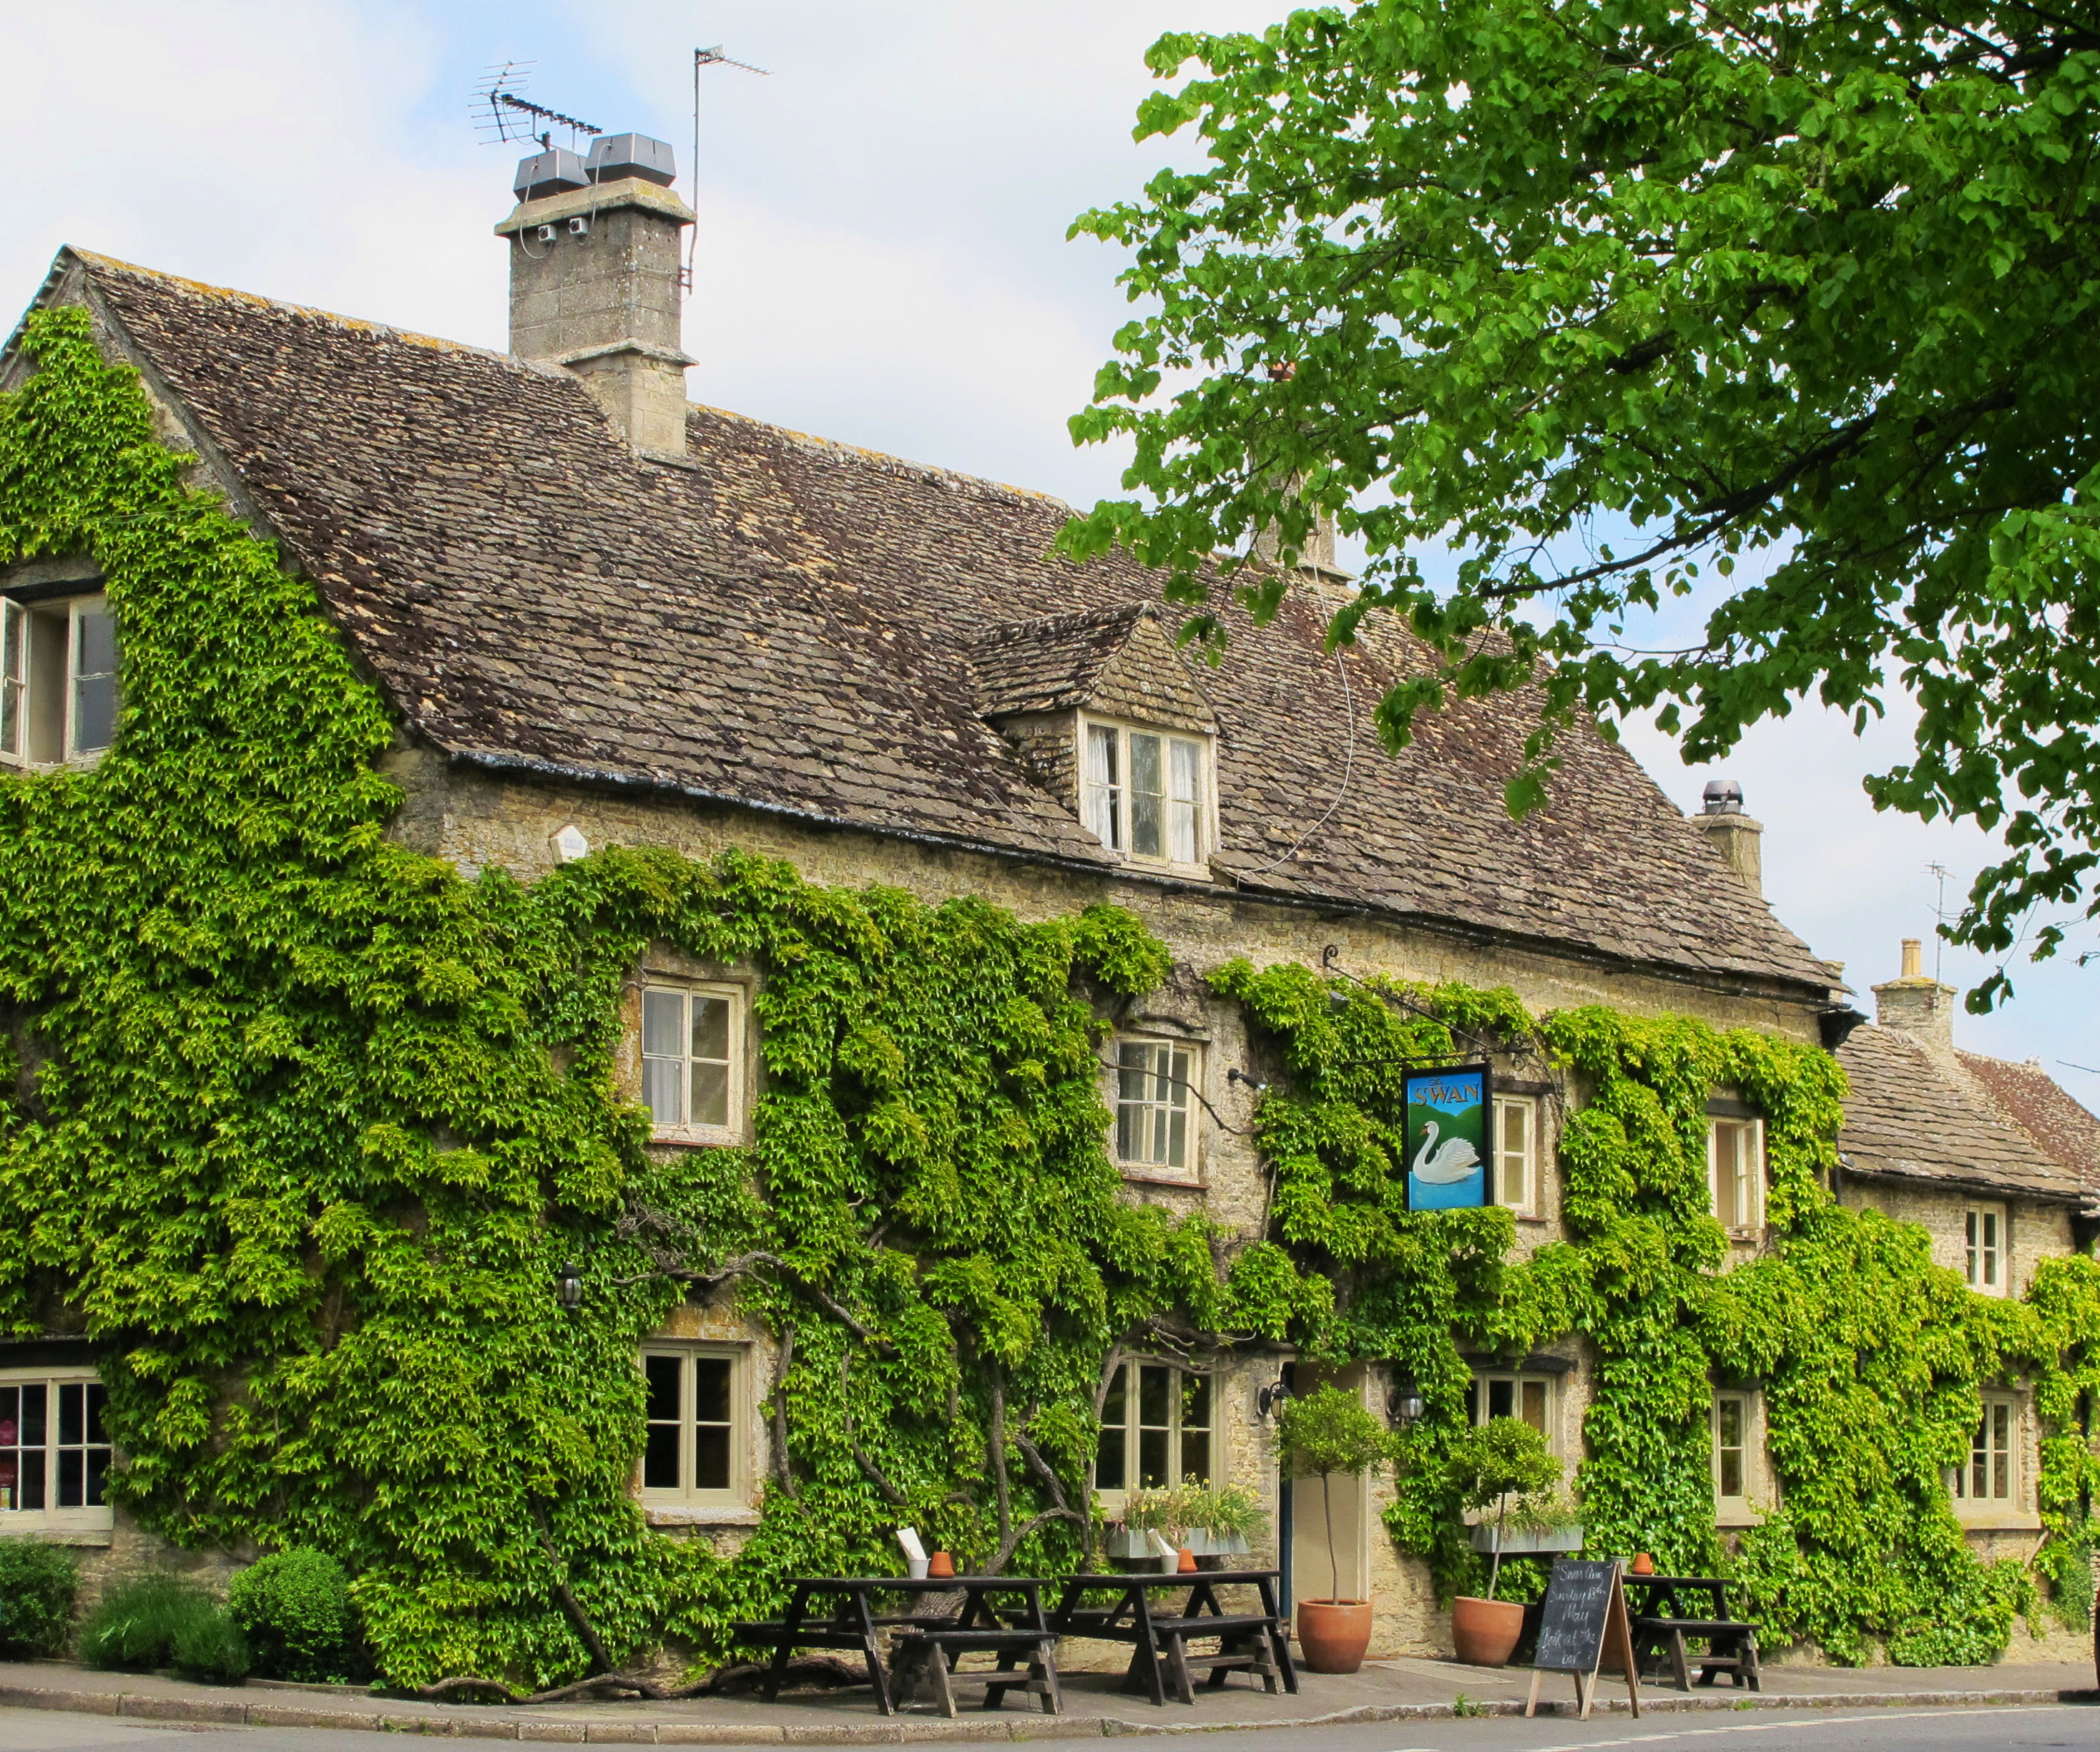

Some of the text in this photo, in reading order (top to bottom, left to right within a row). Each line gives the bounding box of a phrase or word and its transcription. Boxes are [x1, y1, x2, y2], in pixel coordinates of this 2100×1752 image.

[1414, 1083, 1480, 1106] SWAN
[1549, 1585, 1586, 1608] Sunday
[1562, 1603, 1589, 1626] May
[1564, 1630, 1577, 1645] at
[1561, 1650, 1583, 1665] bar
